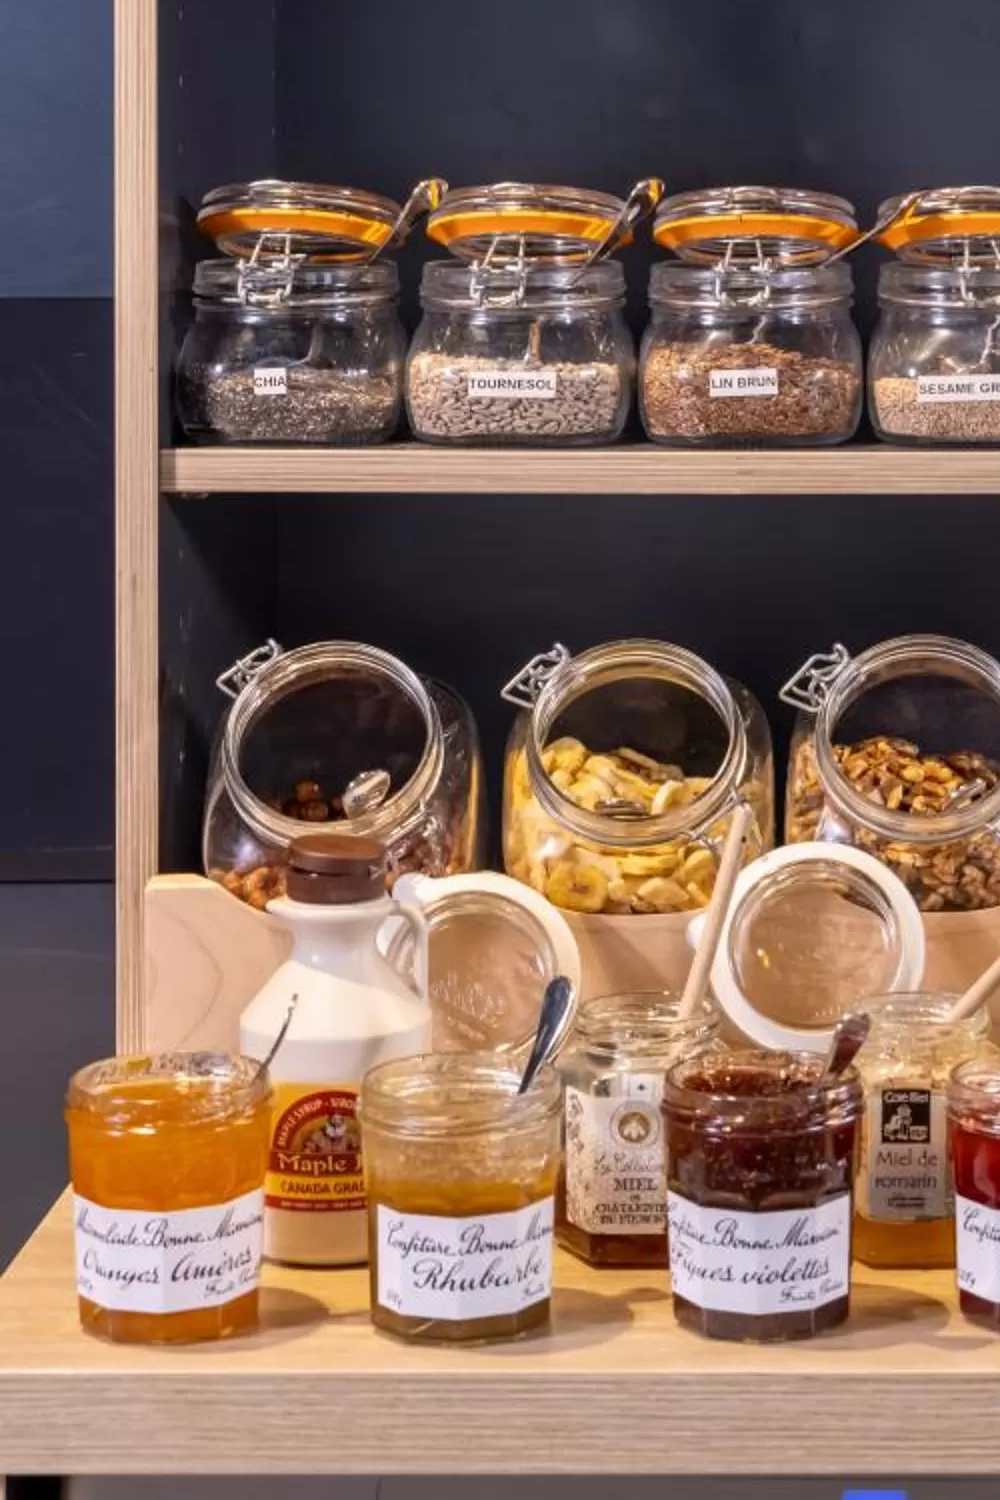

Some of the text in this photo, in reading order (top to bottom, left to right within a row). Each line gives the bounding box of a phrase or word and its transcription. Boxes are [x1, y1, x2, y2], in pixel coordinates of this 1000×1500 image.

[254, 376, 288, 388] CHIA
[471, 378, 554, 390] TOURNESOL
[711, 376, 776, 389] LIN BRUN
[919, 383, 975, 395] SESAME
[278, 1153, 347, 1177] Maple
[877, 1148, 938, 1167] Miel de
[282, 1181, 332, 1194] CANADA
[613, 1177, 658, 1191] MIEL
[875, 1175, 937, 1189] romarin
[142, 1217, 203, 1248] Bonne
[460, 1223, 517, 1257] Bonne
[713, 1217, 772, 1250] Bonne
[413, 1247, 544, 1293] Rhubarbe
[741, 1256, 829, 1285] violettes
